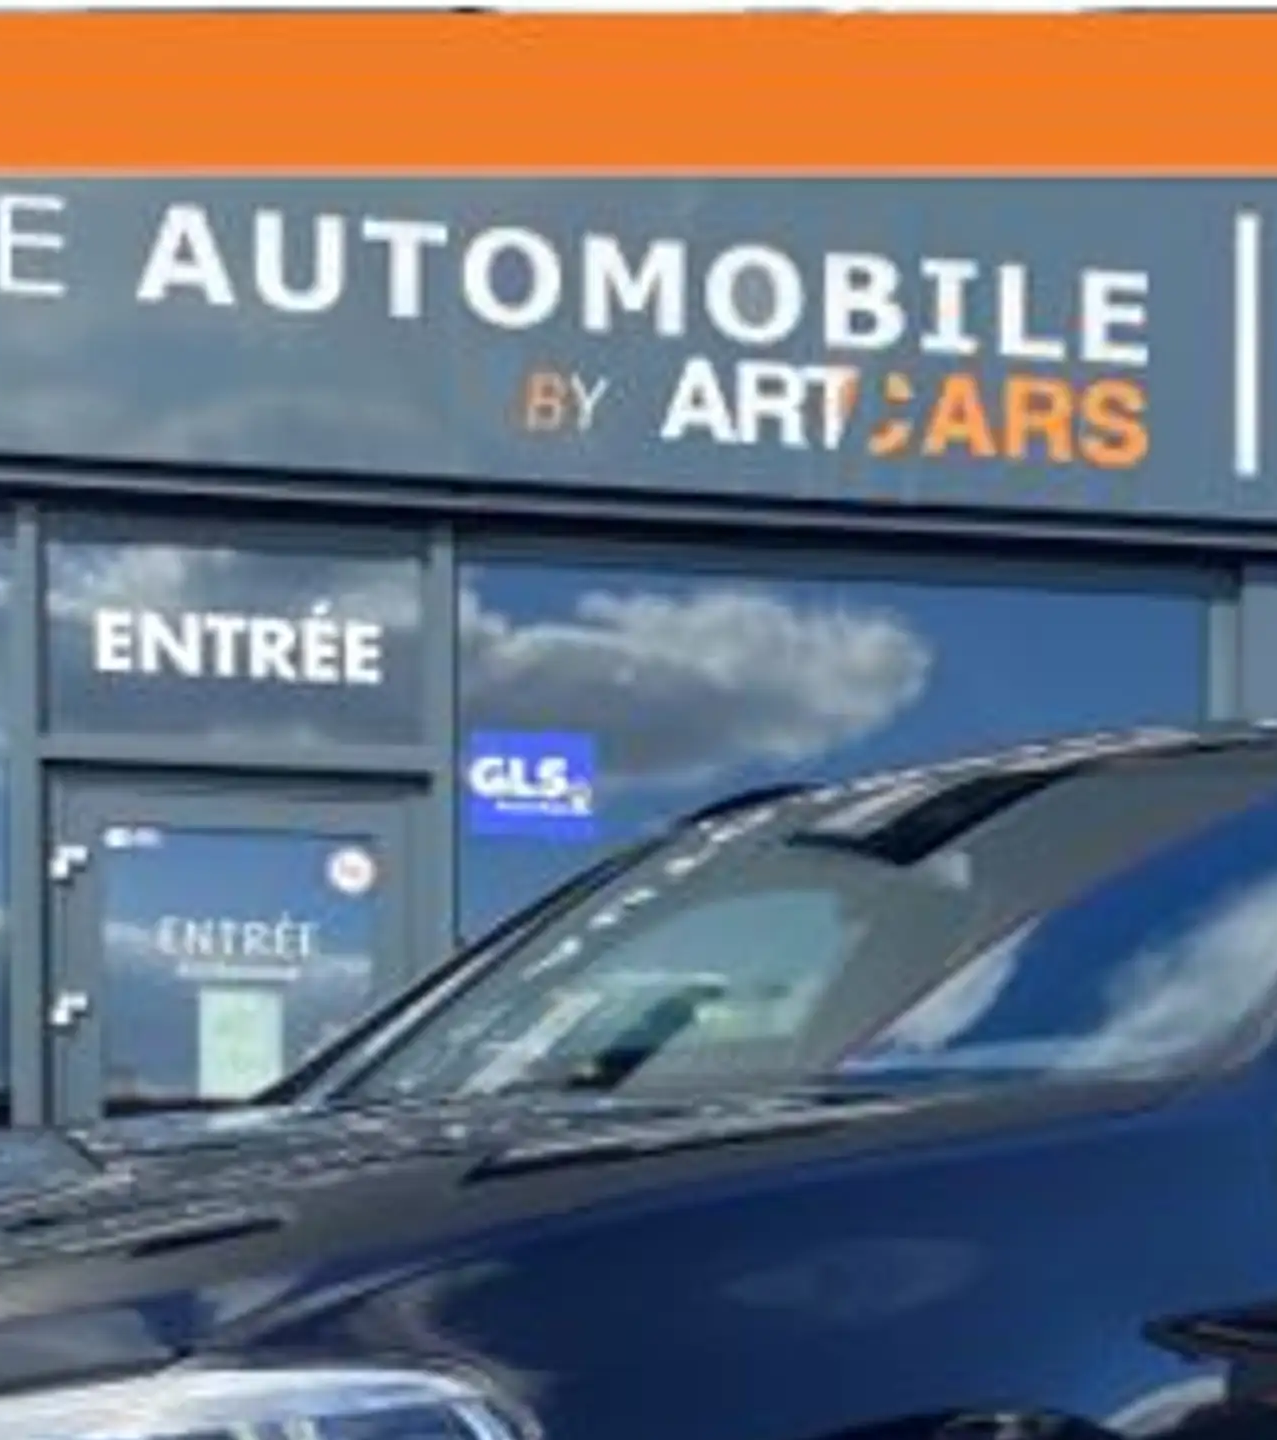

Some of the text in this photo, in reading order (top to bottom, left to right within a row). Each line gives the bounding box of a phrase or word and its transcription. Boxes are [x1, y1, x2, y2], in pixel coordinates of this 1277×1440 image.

[135, 203, 1150, 366] AUTOMOBILE
[525, 370, 608, 434] BY
[93, 598, 383, 685] ENTRÉE
[470, 756, 568, 798] GLS
